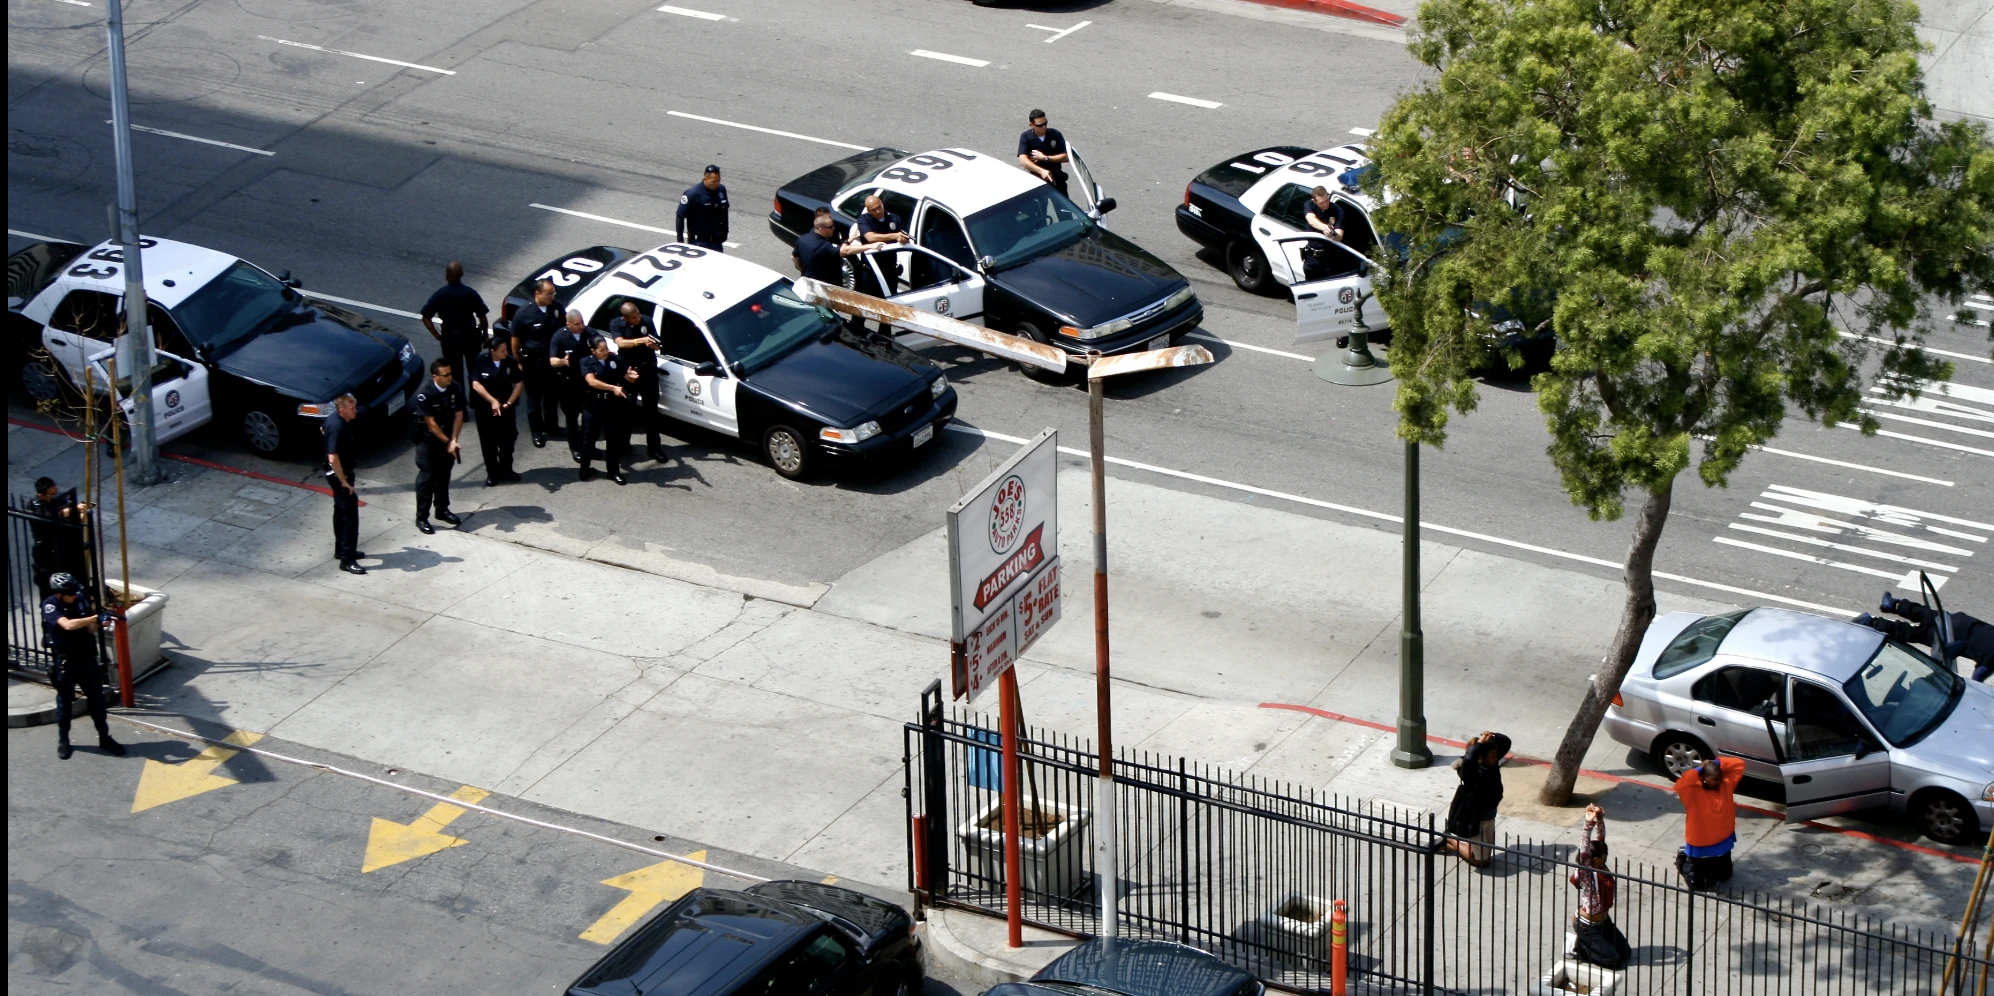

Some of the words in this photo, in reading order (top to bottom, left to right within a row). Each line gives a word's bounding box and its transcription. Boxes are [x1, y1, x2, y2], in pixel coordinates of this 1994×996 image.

[535, 257, 604, 287] 02
[612, 244, 707, 289] 827
[1334, 306, 1355, 314] POLIC
[685, 395, 704, 405] POLICE
[993, 480, 1023, 520] JOE'S
[992, 528, 1006, 548] AUTO
[1007, 508, 1022, 546] PARKS
[1000, 503, 1015, 528] 558
[982, 542, 1036, 602] PARKING
[1038, 566, 1057, 594] FLAT
[1038, 583, 1059, 613] RATE
[1024, 624, 1035, 641] SAT
[1035, 621, 1040, 630] &
[1041, 607, 1053, 625] SUN
